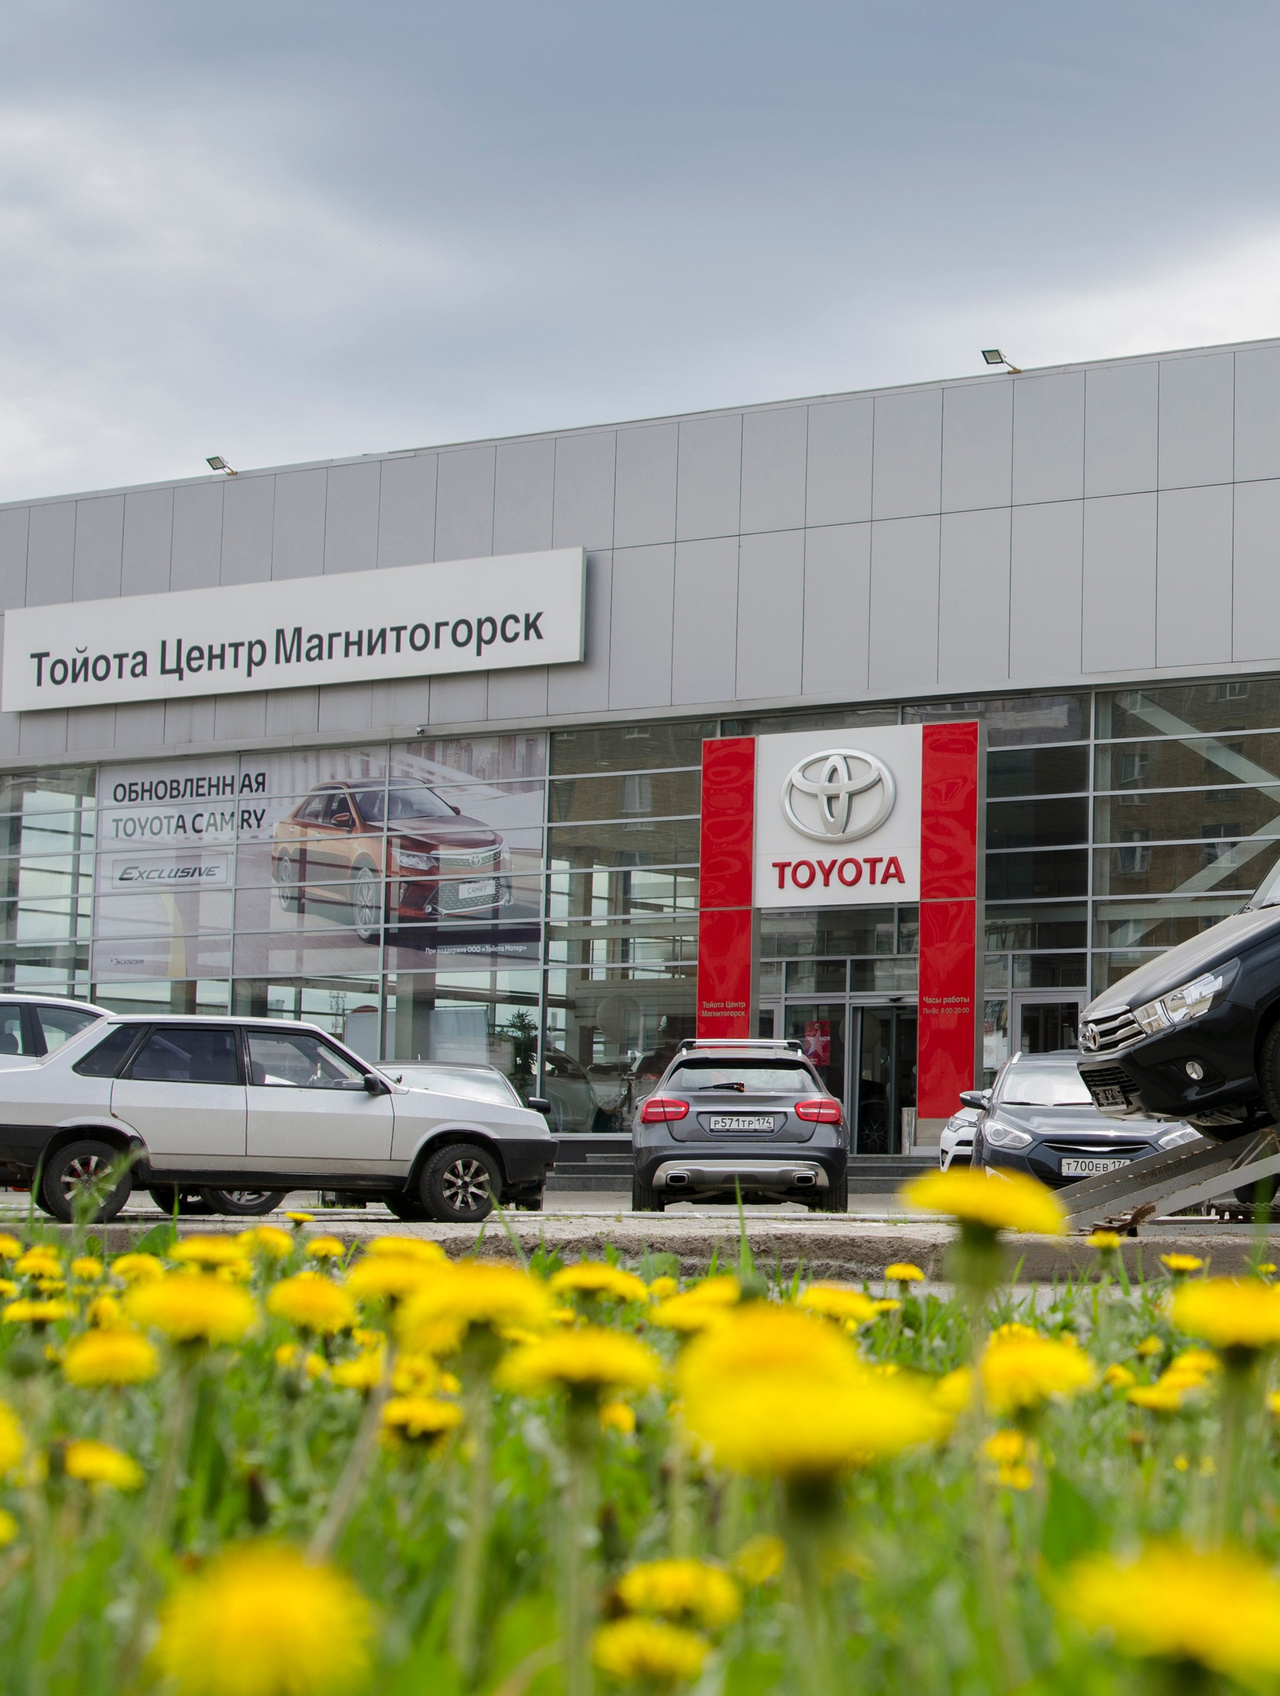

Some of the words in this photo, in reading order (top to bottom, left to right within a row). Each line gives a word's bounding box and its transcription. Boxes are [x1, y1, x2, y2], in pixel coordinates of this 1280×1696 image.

[29, 645, 149, 687] Тойота
[159, 637, 268, 678] Центр
[274, 610, 545, 666] Магнитогорск
[112, 772, 267, 803] ОБНОВЛЕННАЯ
[112, 814, 187, 839] TOYOTA
[191, 808, 266, 834] CAMRY
[771, 856, 906, 889] TOYOTA
[466, 884, 488, 895] CAMRY
[467, 945, 481, 953] ООО
[922, 996, 942, 1004] Часы
[943, 994, 970, 1005] работы
[702, 1001, 725, 1009] Тойота
[725, 1001, 746, 1010] Центр
[701, 1010, 746, 1018] Магнитогорск
